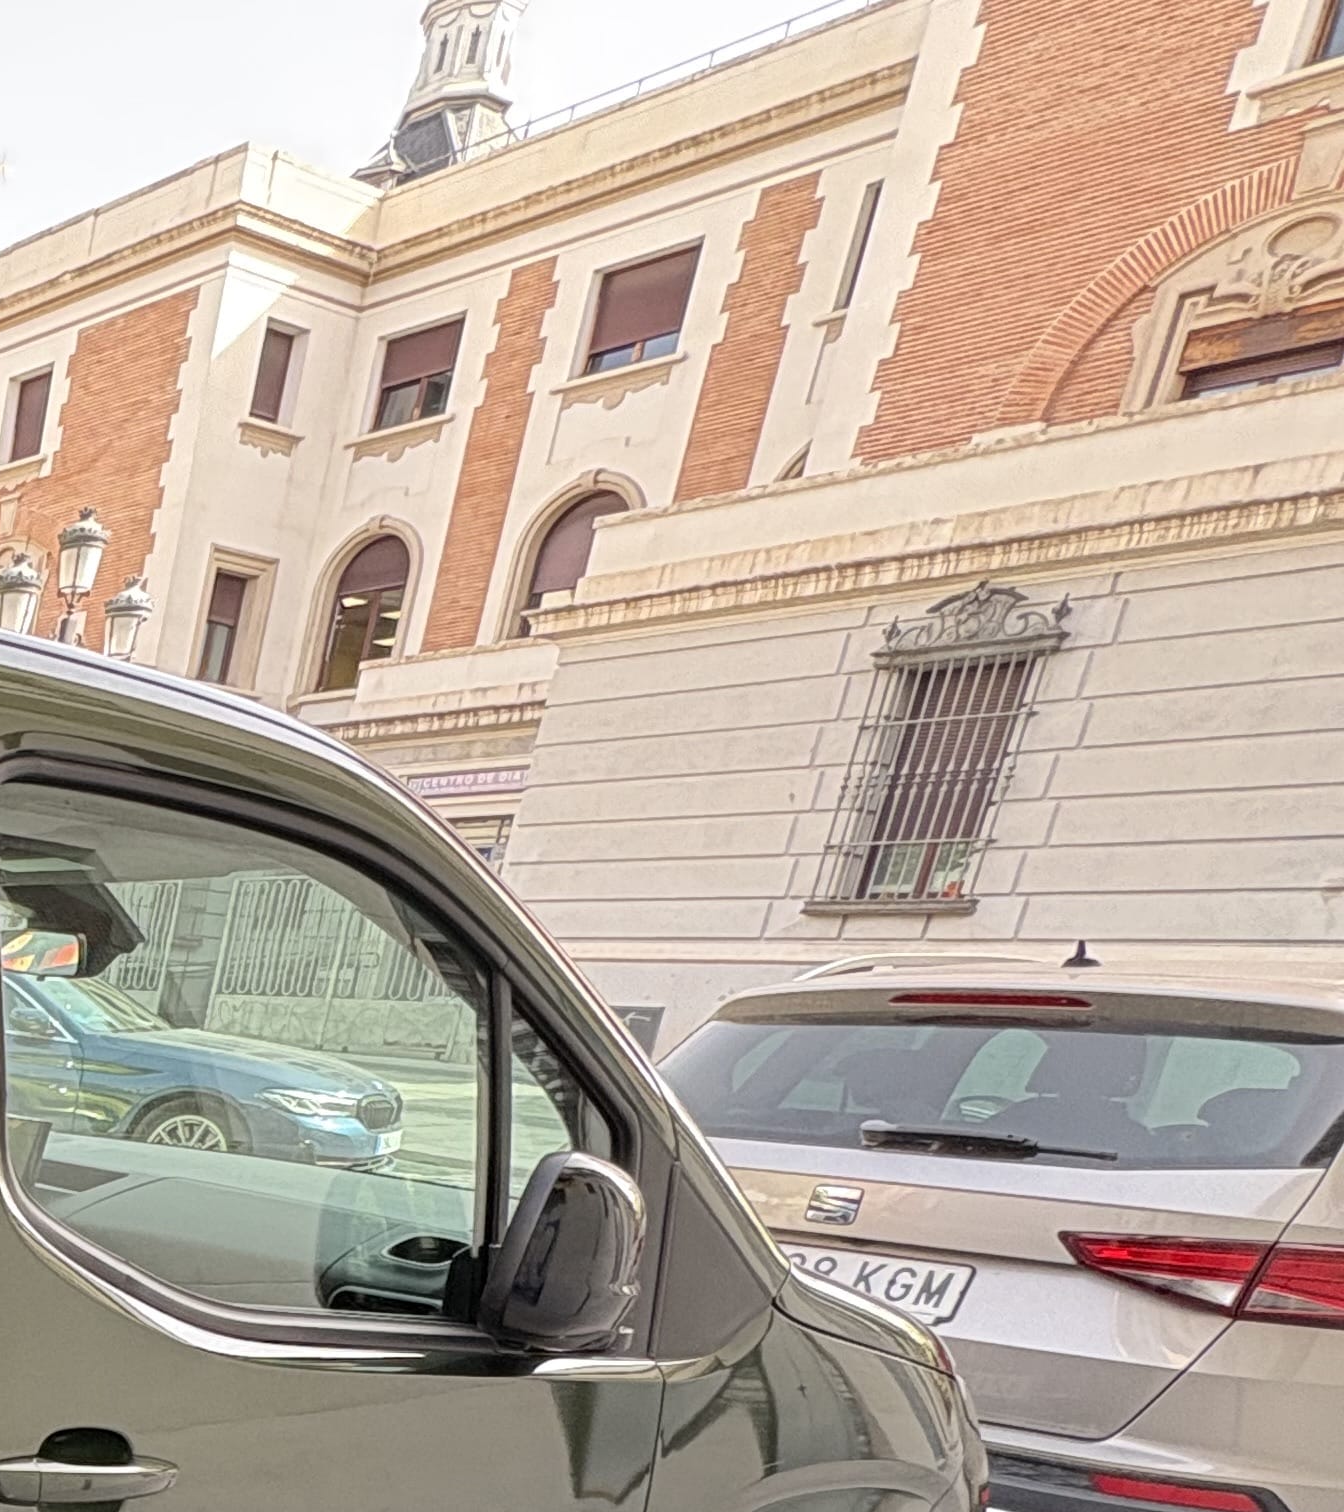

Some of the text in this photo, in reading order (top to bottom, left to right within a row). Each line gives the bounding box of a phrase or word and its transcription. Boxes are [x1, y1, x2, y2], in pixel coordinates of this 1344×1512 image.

[423, 774, 474, 788] CENTRO
[478, 772, 495, 784] DE
[853, 1260, 956, 1309] KGM
